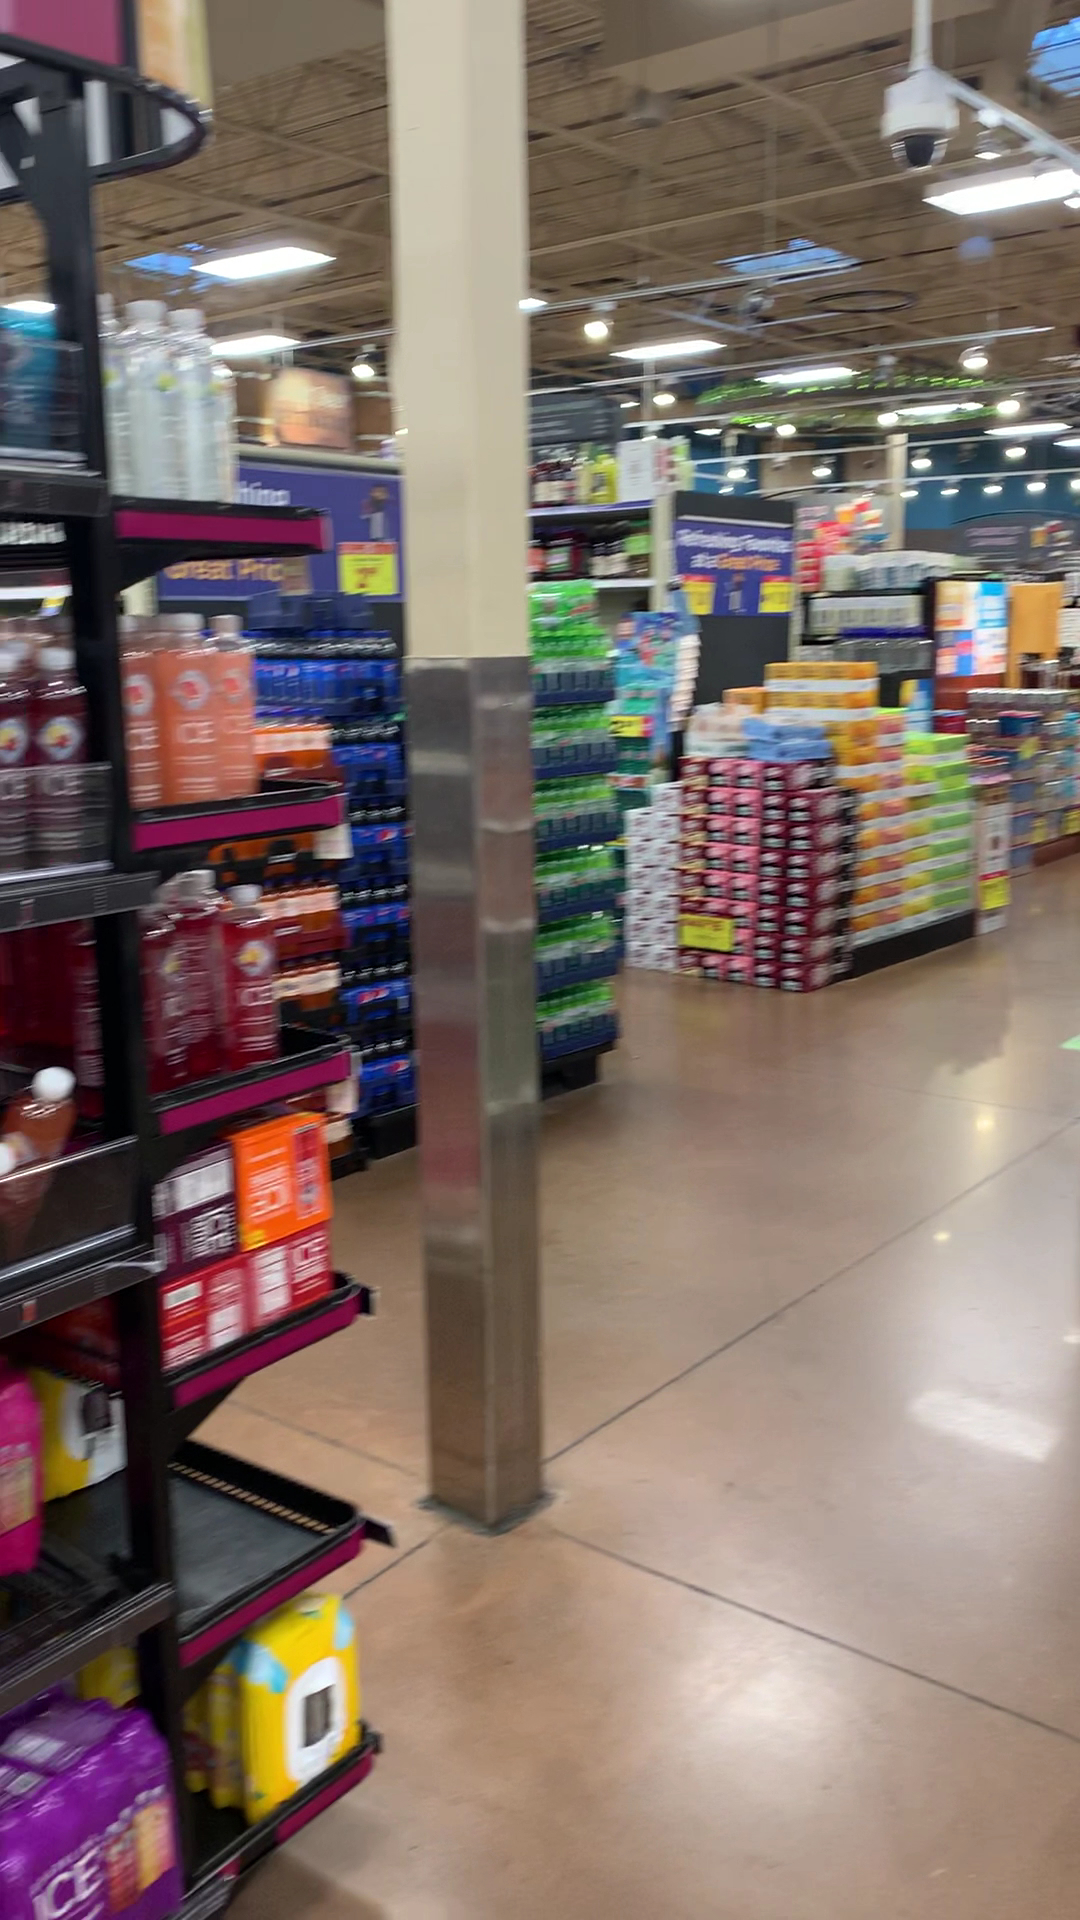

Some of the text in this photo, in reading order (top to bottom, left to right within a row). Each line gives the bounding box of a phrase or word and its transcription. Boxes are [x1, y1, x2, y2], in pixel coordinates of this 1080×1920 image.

[177, 720, 216, 744] ICE
[237, 985, 275, 1007] ICE
[32, 1846, 106, 1920] ICE
